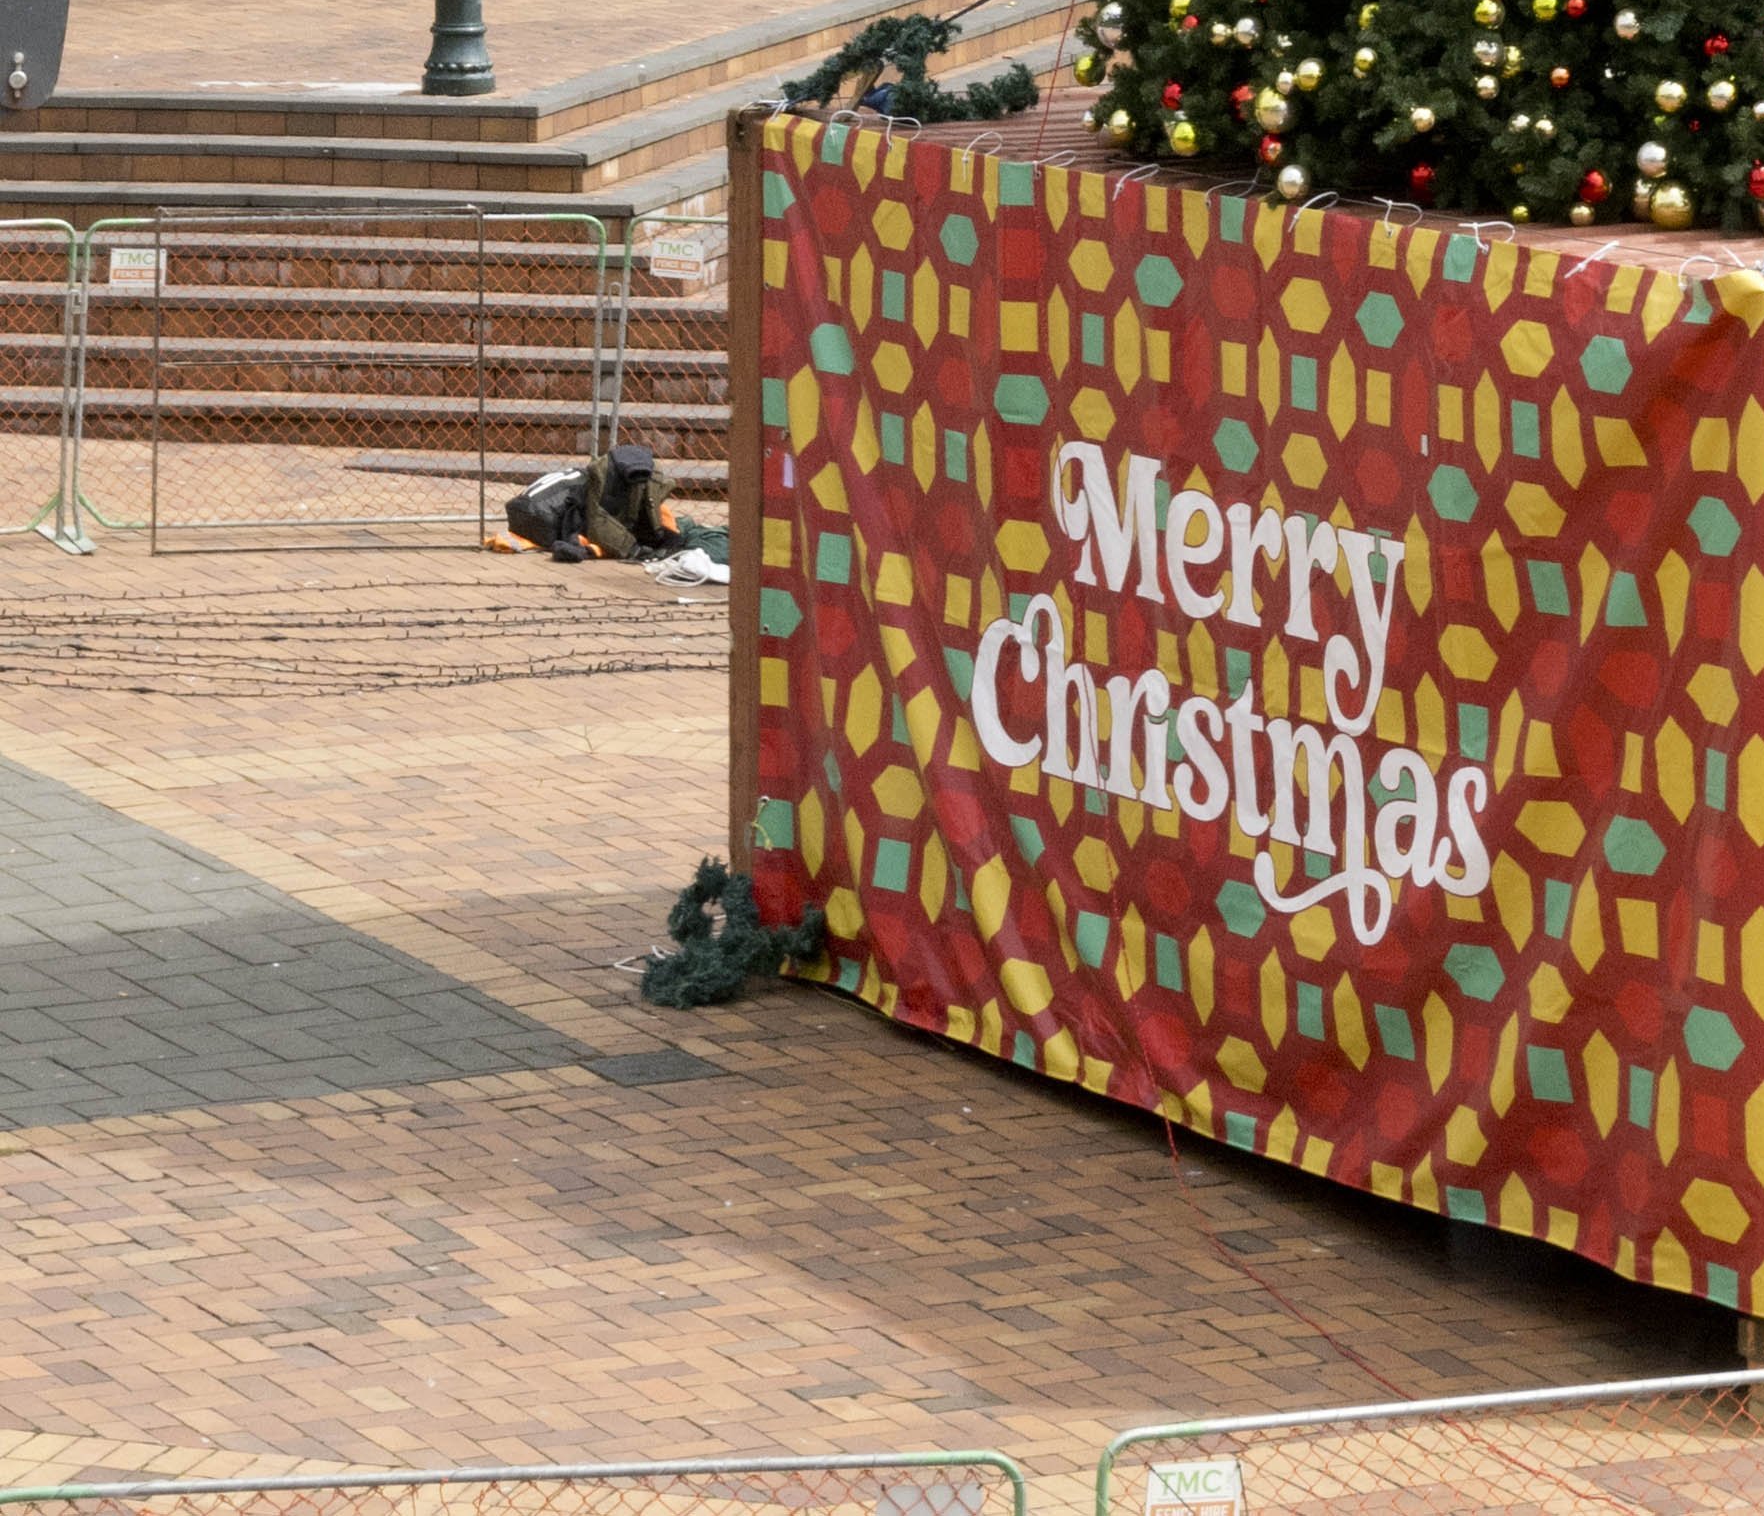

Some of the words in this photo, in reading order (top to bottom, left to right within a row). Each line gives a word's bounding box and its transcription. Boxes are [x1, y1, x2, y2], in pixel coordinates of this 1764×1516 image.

[119, 252, 155, 266] TMC
[655, 241, 694, 257] TMC
[1058, 440, 1406, 737] Merry
[970, 592, 1491, 947] Christmas
[1158, 1469, 1222, 1496] TMC
